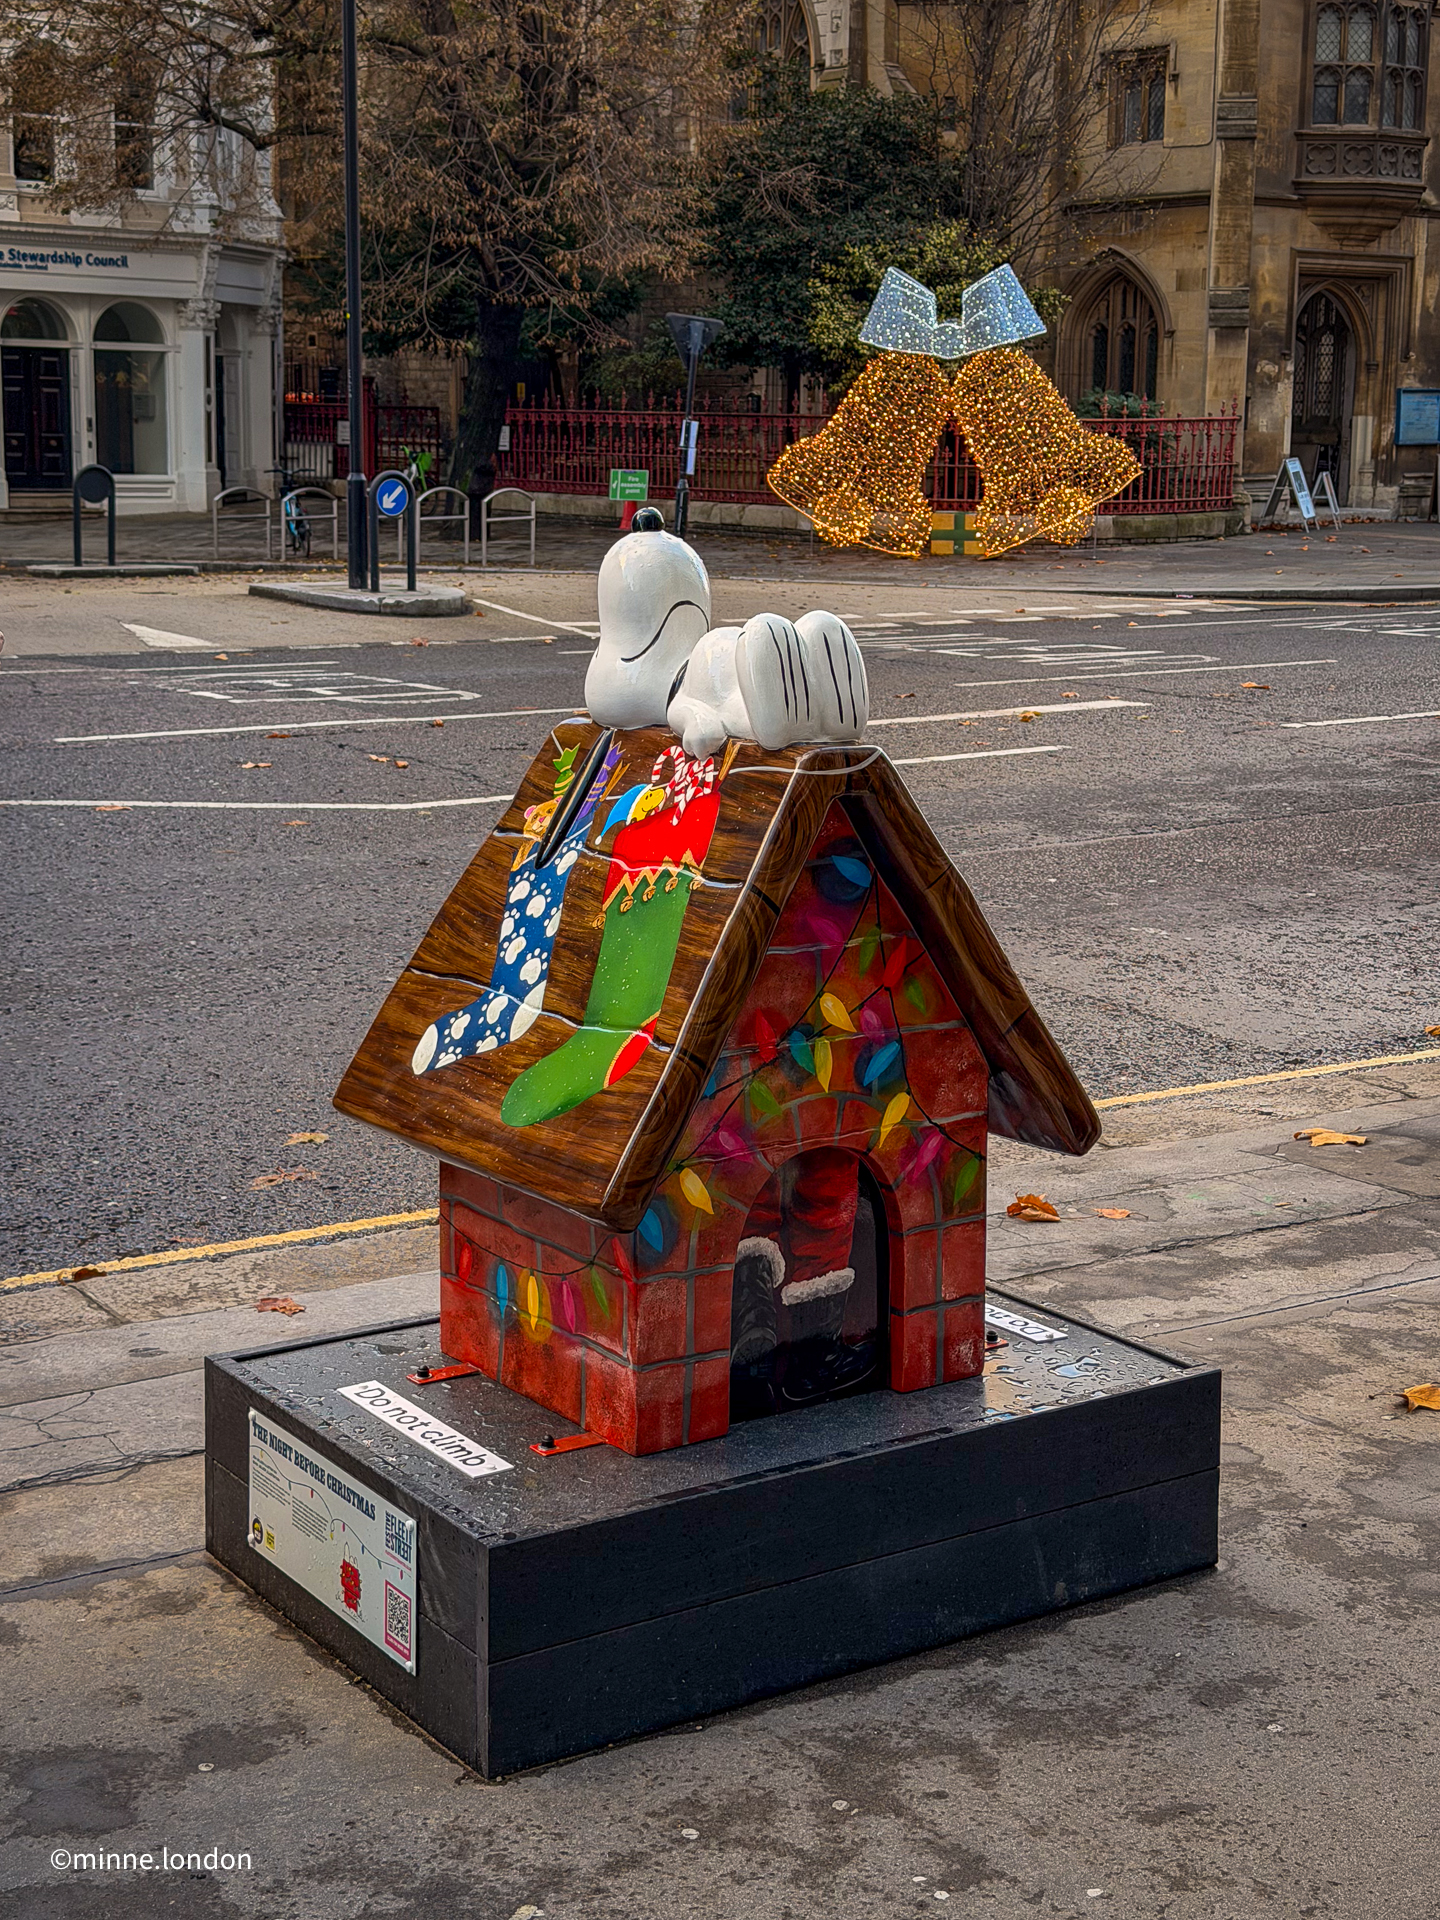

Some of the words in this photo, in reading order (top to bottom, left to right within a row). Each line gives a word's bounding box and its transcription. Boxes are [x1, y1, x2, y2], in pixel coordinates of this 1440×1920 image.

[8, 247, 82, 268] Stewardship
[86, 252, 129, 268] Council
[354, 1387, 392, 1407] Do
[383, 1405, 432, 1431] not
[420, 1430, 487, 1467] climb
[252, 1421, 269, 1445] THE
[268, 1432, 294, 1463] NIGHT
[293, 1449, 326, 1486] BEFORE
[326, 1472, 376, 1522] CHRISTMAS
